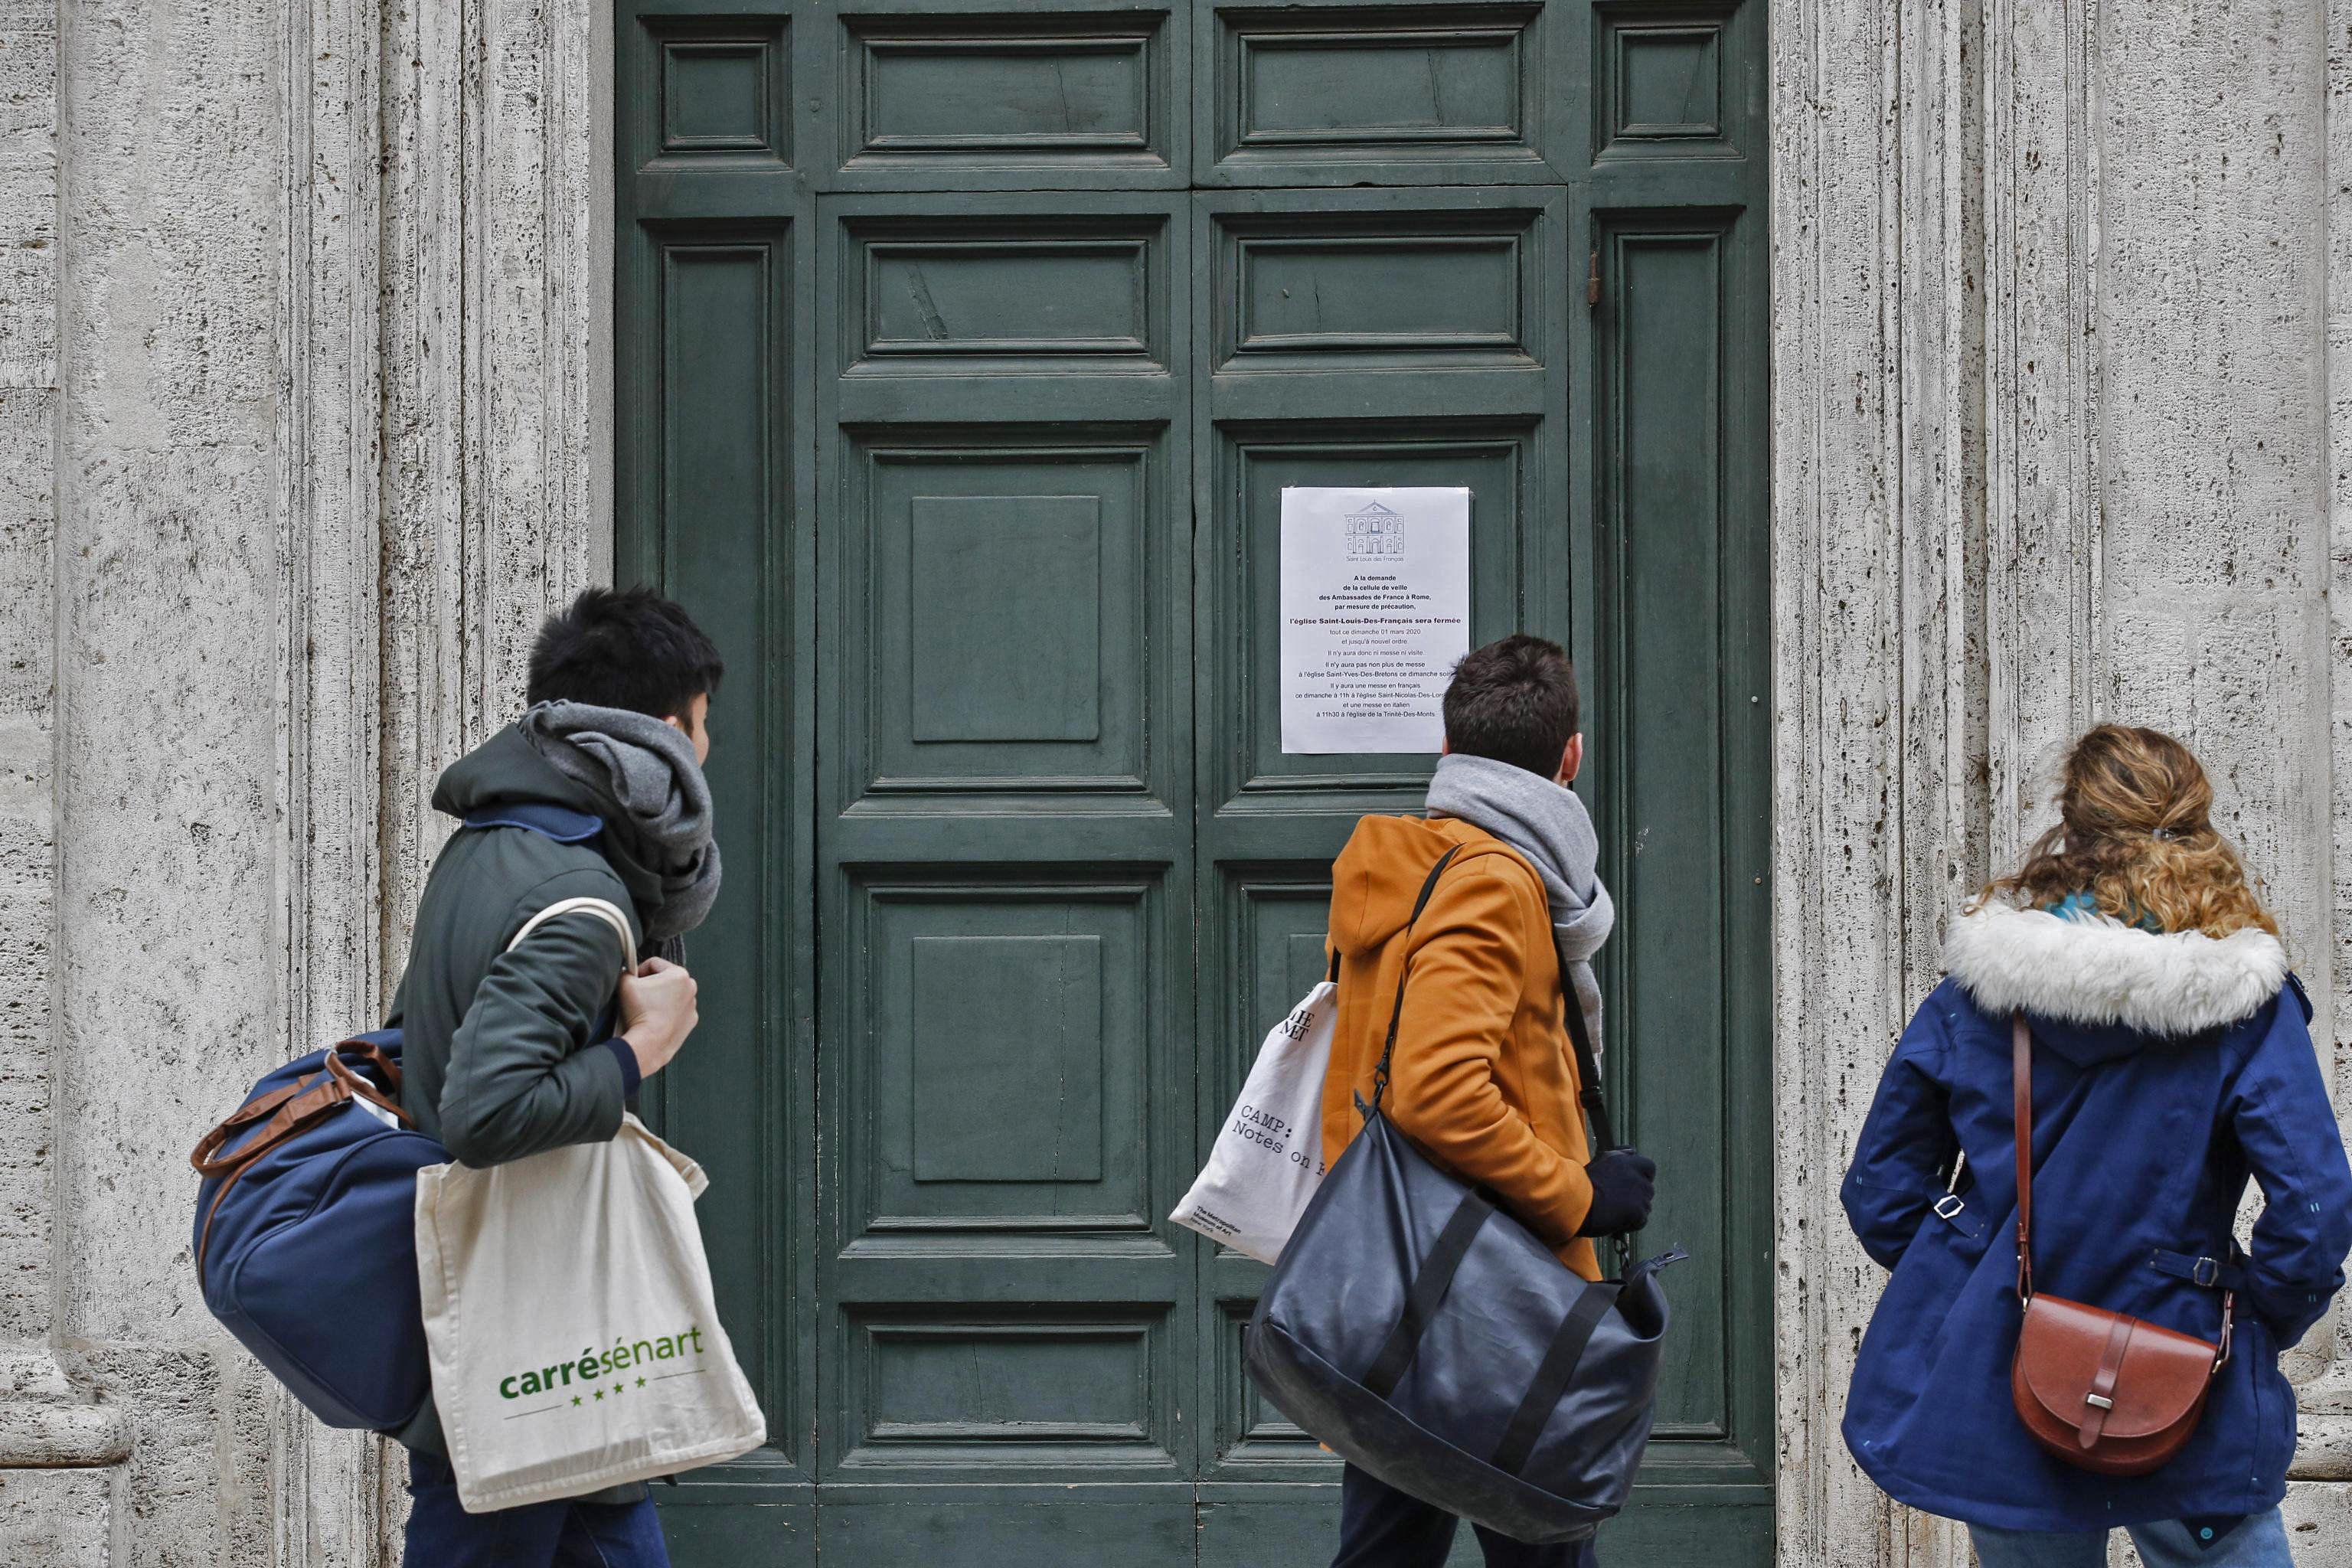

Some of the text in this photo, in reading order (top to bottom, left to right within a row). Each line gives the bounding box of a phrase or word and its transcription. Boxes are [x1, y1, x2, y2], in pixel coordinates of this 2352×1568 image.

[1241, 1105, 1292, 1138] CAMP:
[1233, 1120, 1283, 1154] Notes
[1291, 1152, 1311, 1169] on
